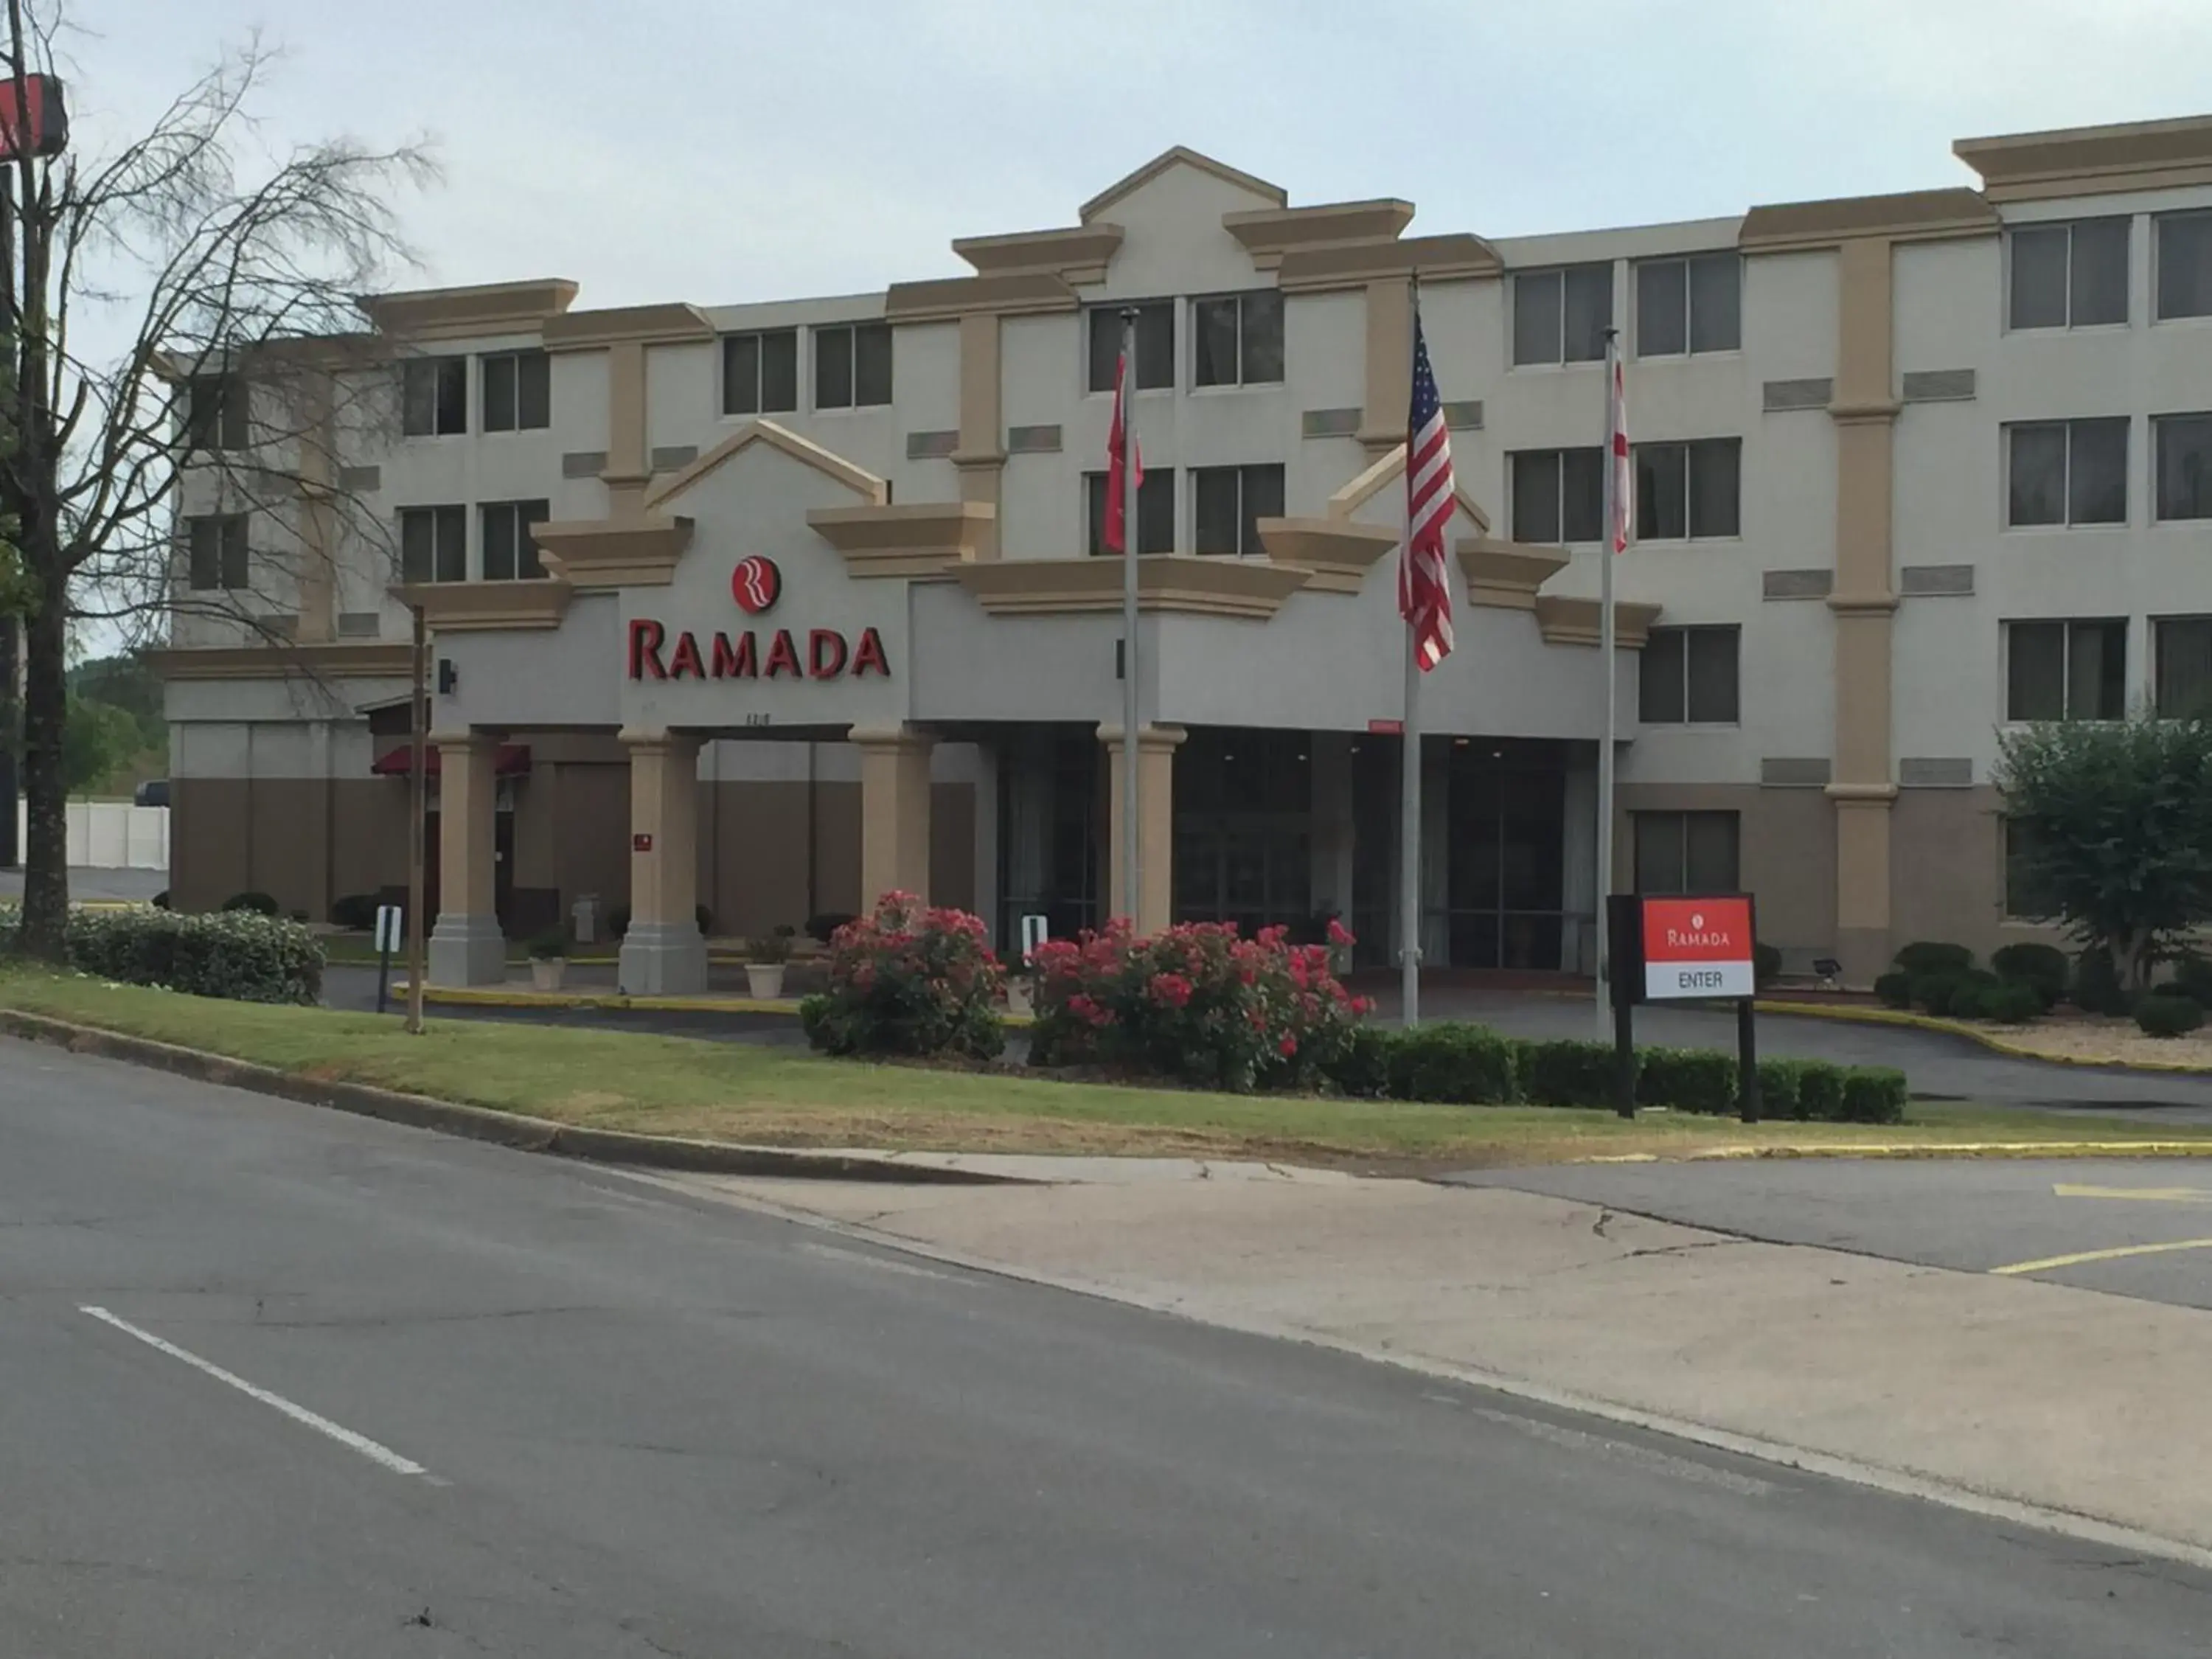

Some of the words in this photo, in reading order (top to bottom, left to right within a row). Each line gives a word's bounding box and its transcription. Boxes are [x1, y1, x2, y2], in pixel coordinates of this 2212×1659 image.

[628, 618, 891, 681] RAMADA
[1667, 928, 1731, 947] RAMADA
[1678, 971, 1723, 989] ENTER
